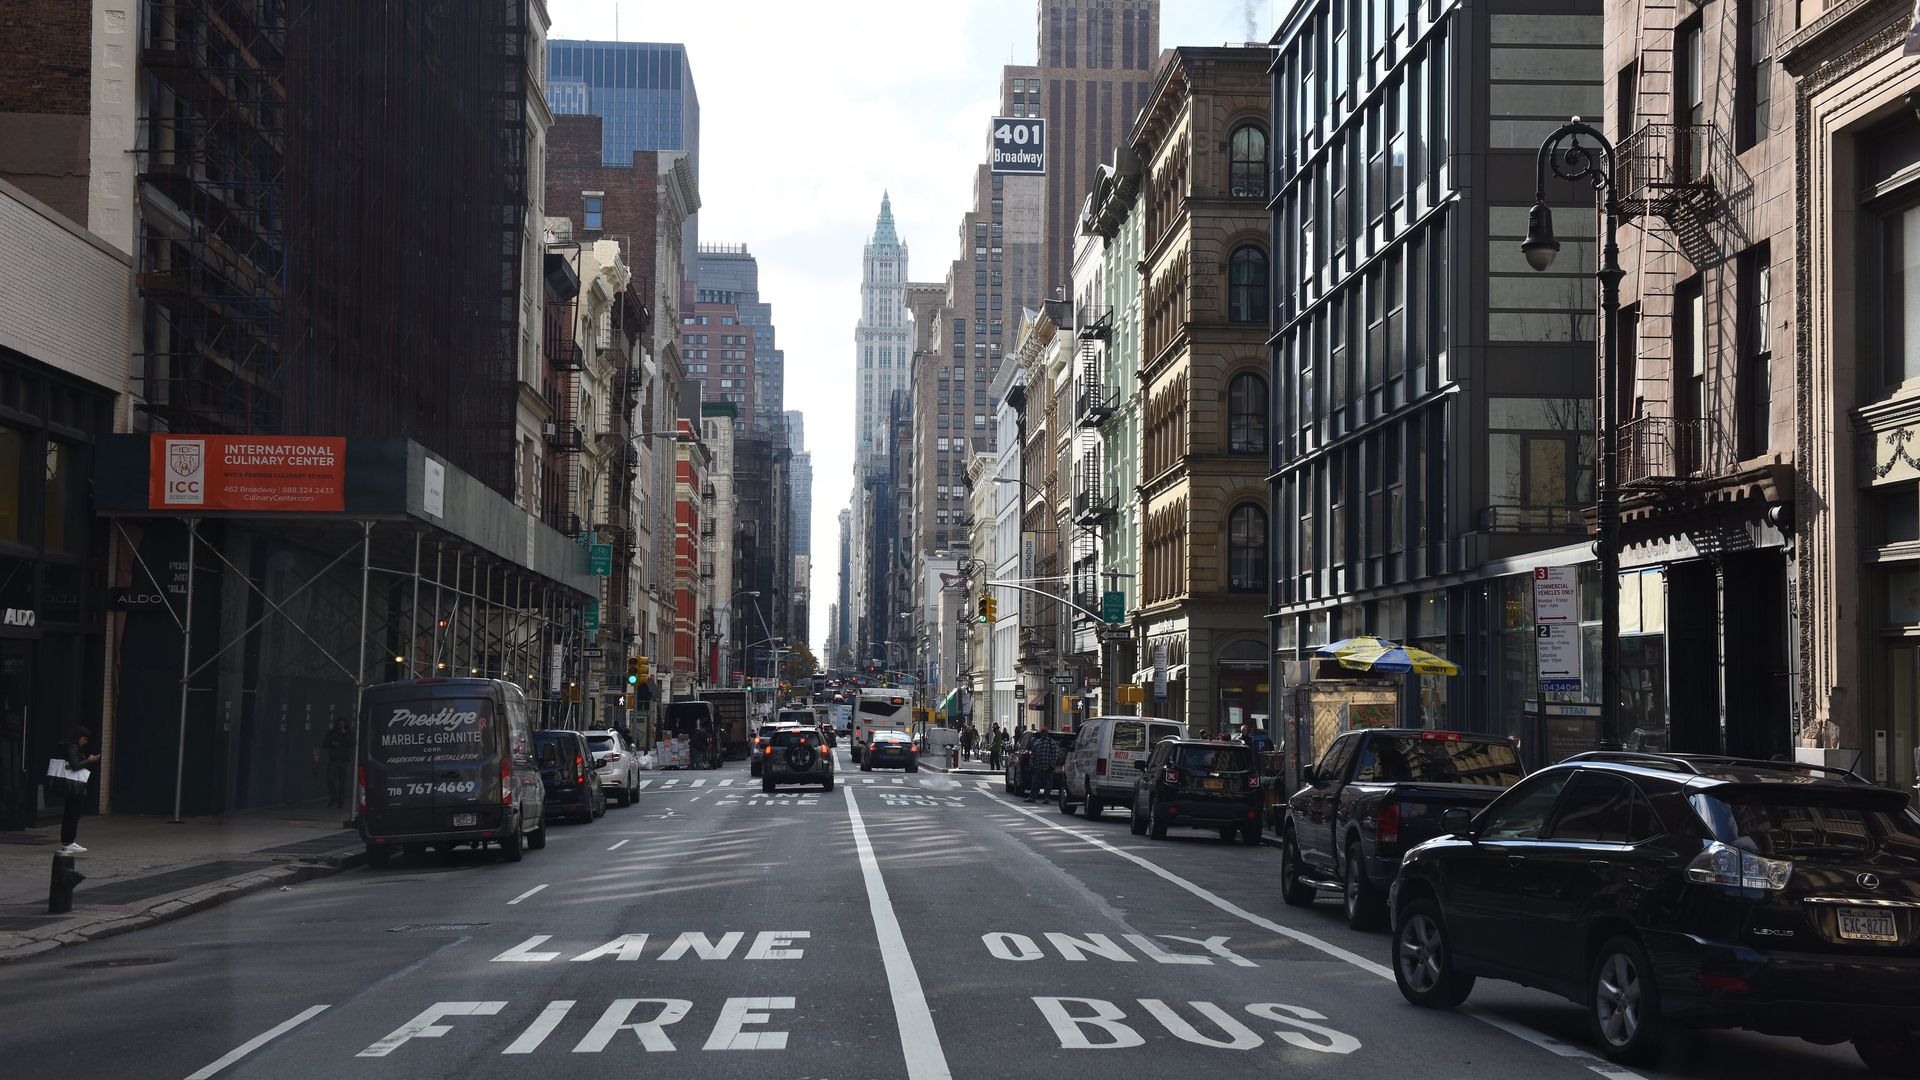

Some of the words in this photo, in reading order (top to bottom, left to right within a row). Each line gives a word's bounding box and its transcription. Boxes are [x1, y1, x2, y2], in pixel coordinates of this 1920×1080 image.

[994, 124, 1040, 145] 401
[994, 149, 1043, 168] Broadway
[178, 446, 193, 454] ICC
[224, 444, 334, 456] INTERNATIONAL
[224, 456, 285, 465] CULINARY
[288, 457, 335, 466] CENTER
[169, 481, 199, 493] ICC
[240, 486, 276, 494] Broadway
[243, 494, 314, 502] CulinaryCenter.com
[169, 561, 190, 570] POS
[174, 572, 188, 582] NO
[1538, 568, 1546, 579] 3
[117, 594, 162, 604] ALDO
[4, 607, 35, 627] ALDO
[1540, 626, 1547, 637] 2
[1560, 706, 1588, 715] TITAN
[387, 707, 478, 732] Prestige
[381, 733, 425, 746] MARBLE
[426, 735, 432, 744] &
[434, 731, 481, 744] GRANITE
[386, 755, 426, 764] FABRICATION
[433, 753, 479, 762] INSTALLATION
[387, 787, 402, 796] 718
[1843, 916, 1862, 934] EXC
[1866, 918, 1889, 935] 8277
[1753, 928, 1795, 937] LEXUS
[489, 930, 811, 962] LANE
[981, 931, 1261, 968] ONLY
[354, 996, 797, 1057] FIRE
[1031, 996, 1362, 1054] BUS
